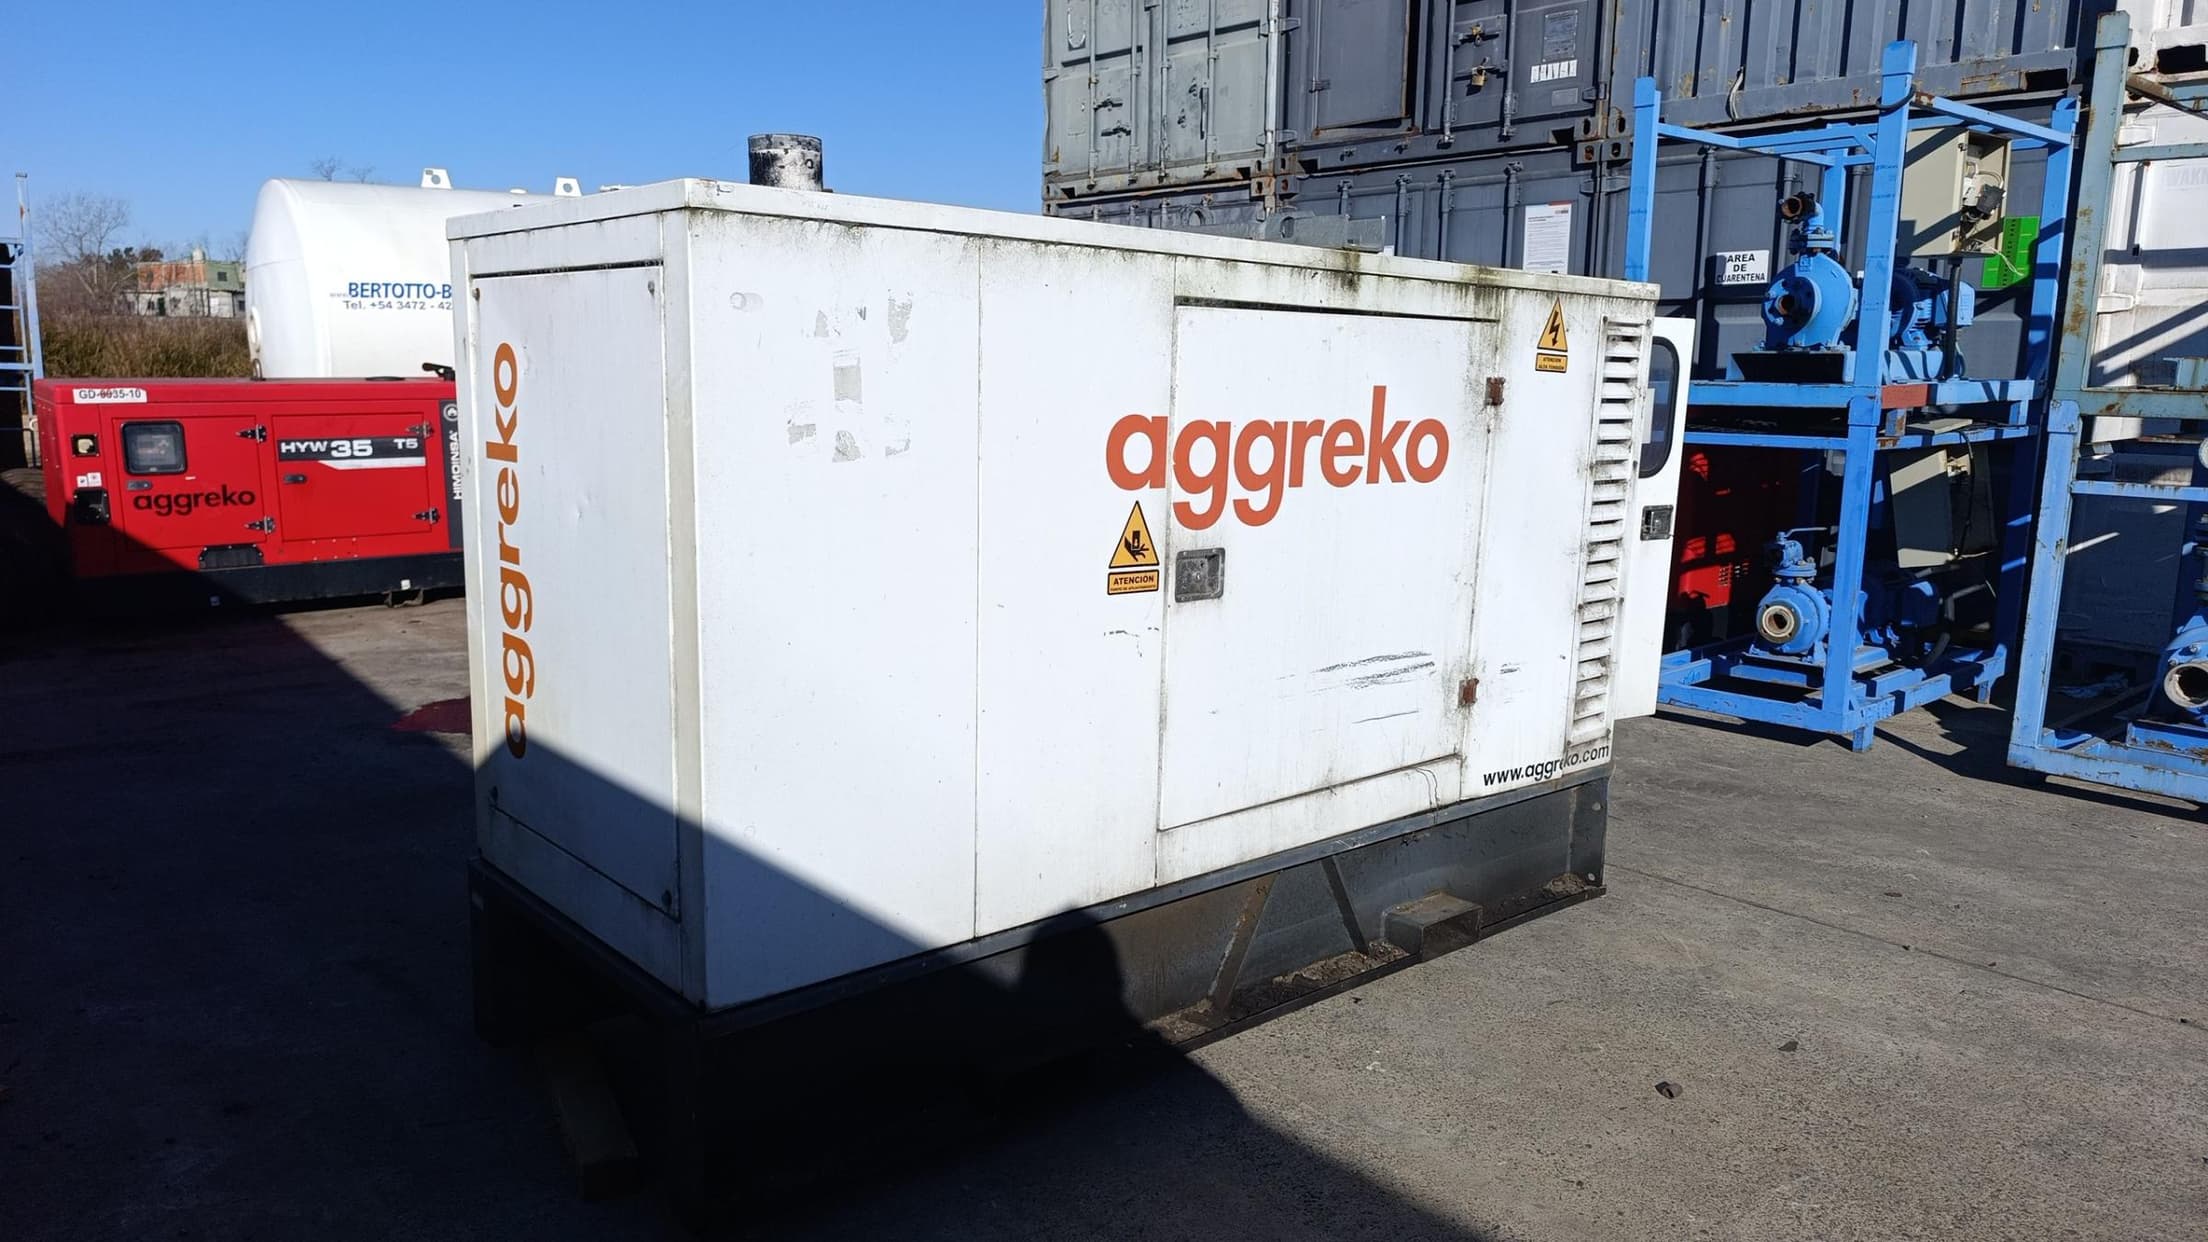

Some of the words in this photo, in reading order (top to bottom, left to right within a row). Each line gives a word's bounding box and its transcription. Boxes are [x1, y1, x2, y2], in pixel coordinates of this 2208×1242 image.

[1727, 253, 1755, 263] AREA
[1733, 263, 1747, 272] DE
[343, 300, 366, 310] Tel.
[370, 301, 392, 310] +54
[397, 301, 426, 310] 3472
[280, 441, 328, 453] HYW
[330, 440, 373, 457] 35
[393, 438, 418, 449] T5
[1105, 385, 1450, 531] aggreko
[449, 430, 462, 500] HIMOINSA
[133, 484, 256, 516] aggreko
[486, 342, 536, 760] aggreko
